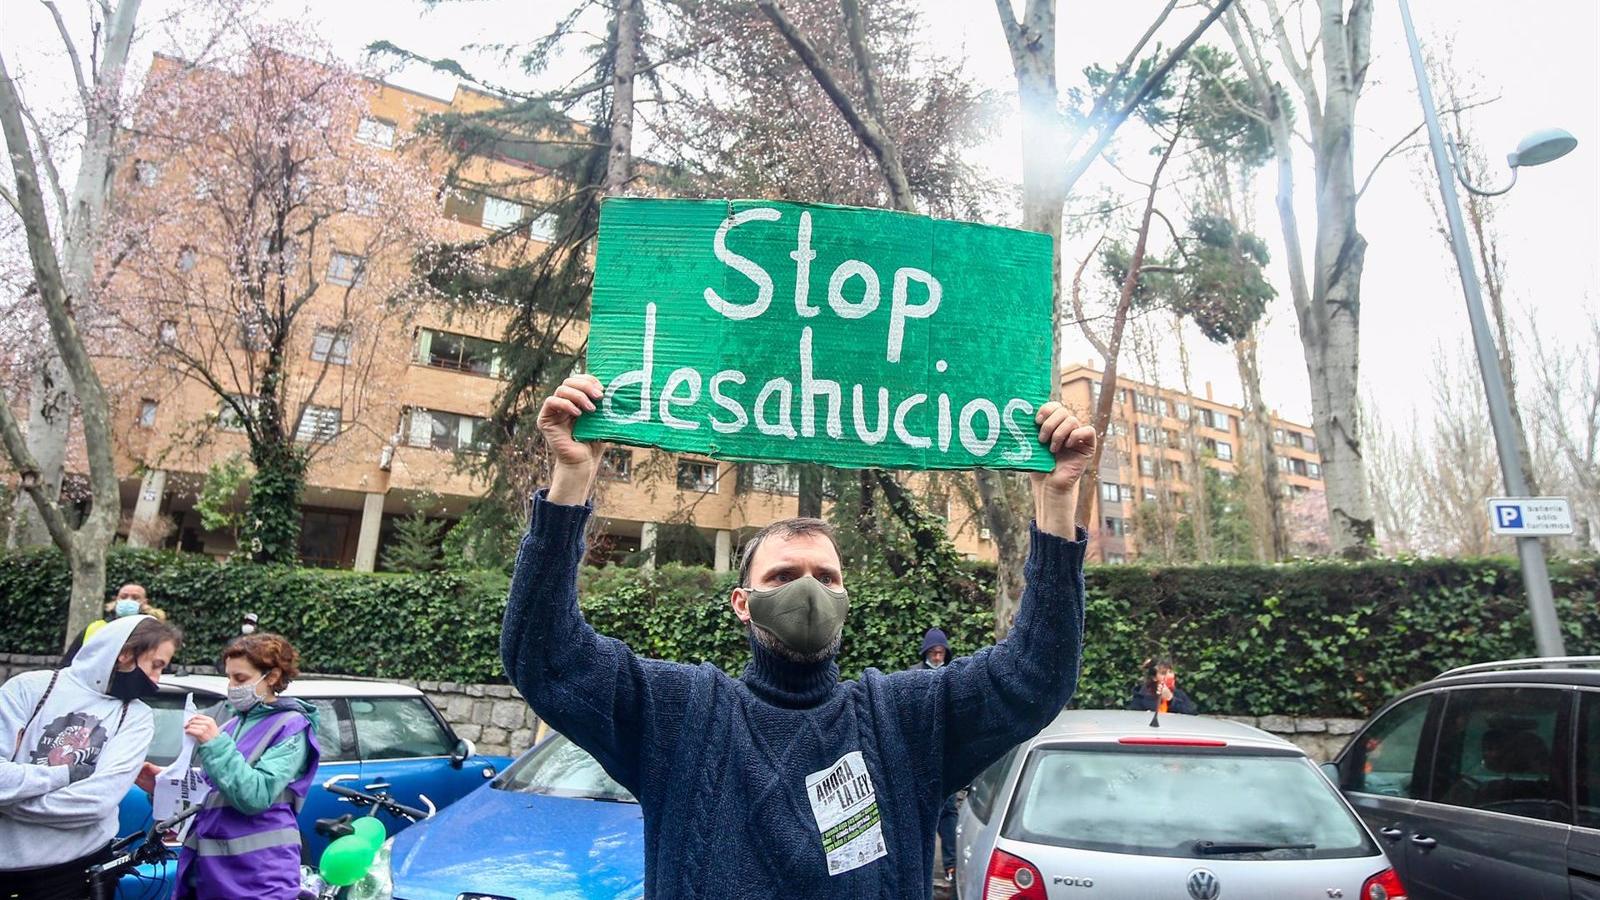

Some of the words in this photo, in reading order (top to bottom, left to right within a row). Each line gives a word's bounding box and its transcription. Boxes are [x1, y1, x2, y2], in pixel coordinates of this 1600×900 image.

[703, 207, 942, 363] Stop
[601, 301, 1035, 463] desahucios
[1500, 507, 1518, 526] P
[816, 760, 854, 802] AHORA
[836, 784, 854, 809] LA
[853, 773, 871, 800] LEY
[1053, 875, 1094, 888] POLO
